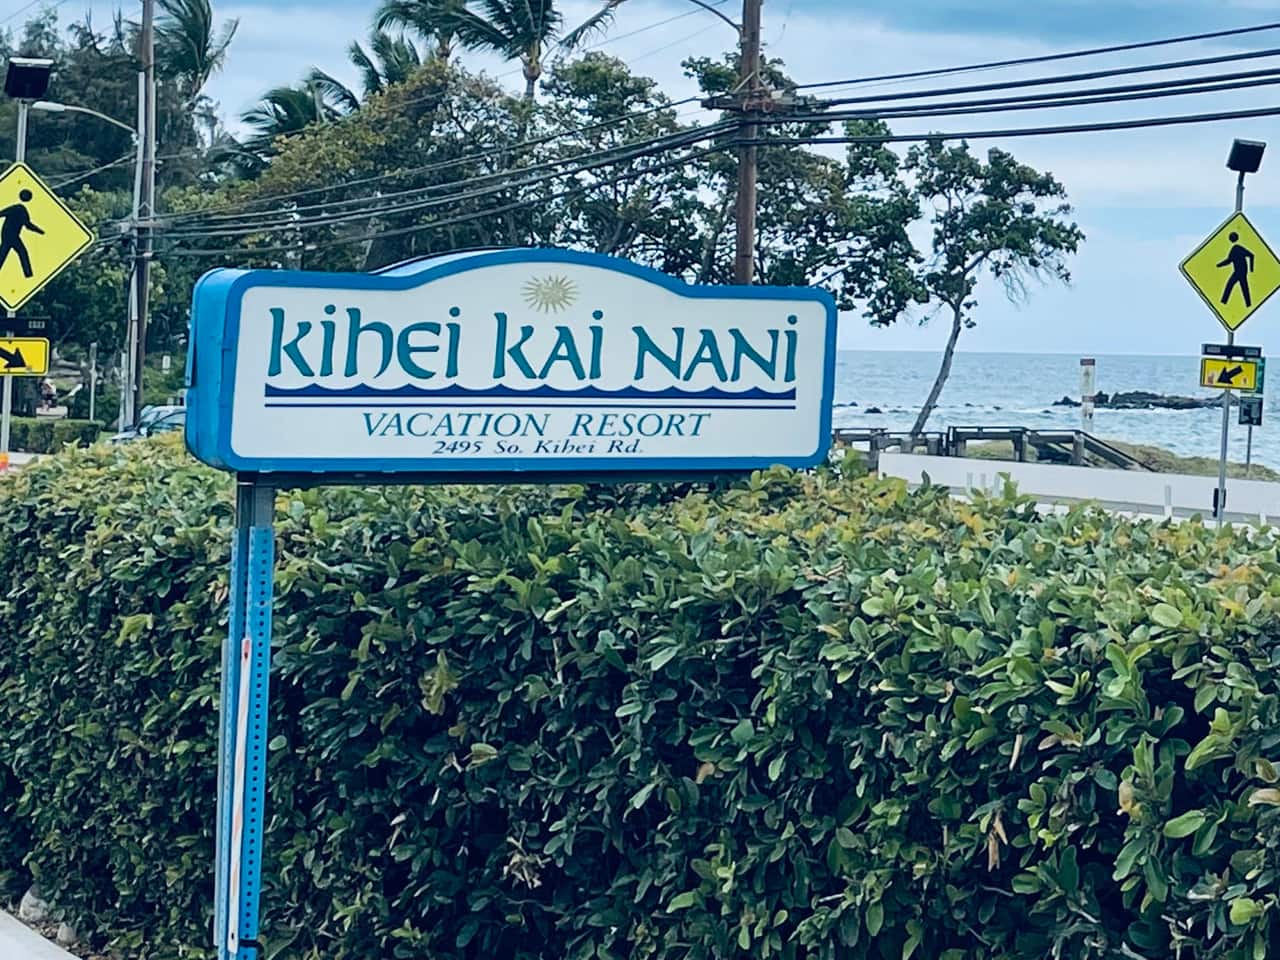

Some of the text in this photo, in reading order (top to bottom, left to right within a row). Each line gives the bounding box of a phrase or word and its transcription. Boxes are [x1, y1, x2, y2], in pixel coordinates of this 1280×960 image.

[362, 412, 712, 437] VACATION RESORT
[432, 440, 483, 454] 2495
[533, 439, 596, 454] Kihei
